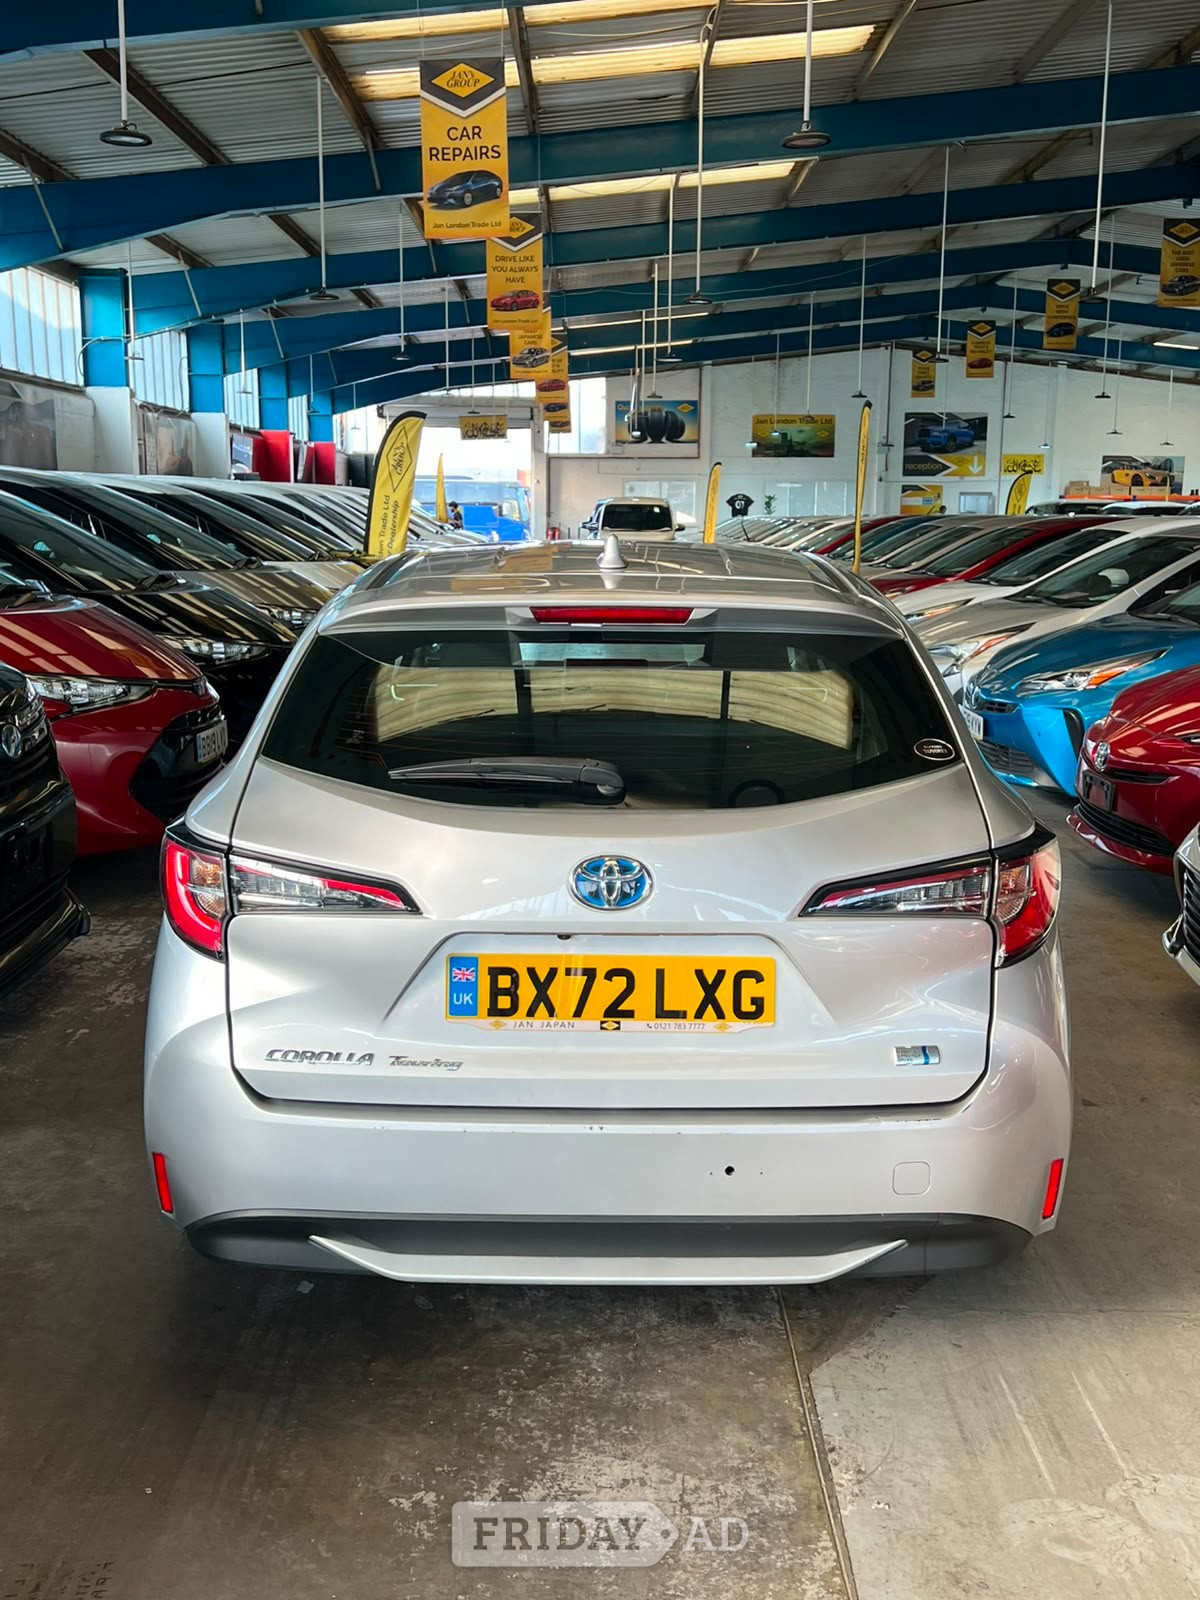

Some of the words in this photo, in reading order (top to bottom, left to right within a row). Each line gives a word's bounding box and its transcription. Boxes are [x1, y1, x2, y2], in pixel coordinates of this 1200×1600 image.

[446, 78, 480, 88] GROUP
[447, 126, 482, 141] CAR
[429, 145, 501, 161] REPAIRS
[445, 221, 470, 229] London
[755, 417, 768, 425] Jan
[820, 417, 833, 425] Ltd
[904, 462, 943, 471] reception
[383, 494, 391, 510] Ltd
[387, 500, 400, 549] Dealership
[453, 993, 474, 1006] UK
[487, 967, 635, 1019] BX72
[655, 968, 765, 1020] LXG
[513, 1020, 534, 1028] JAN
[540, 1021, 575, 1029] JAPAN
[263, 1049, 375, 1066] COROLLA
[388, 1055, 465, 1071] Touring
